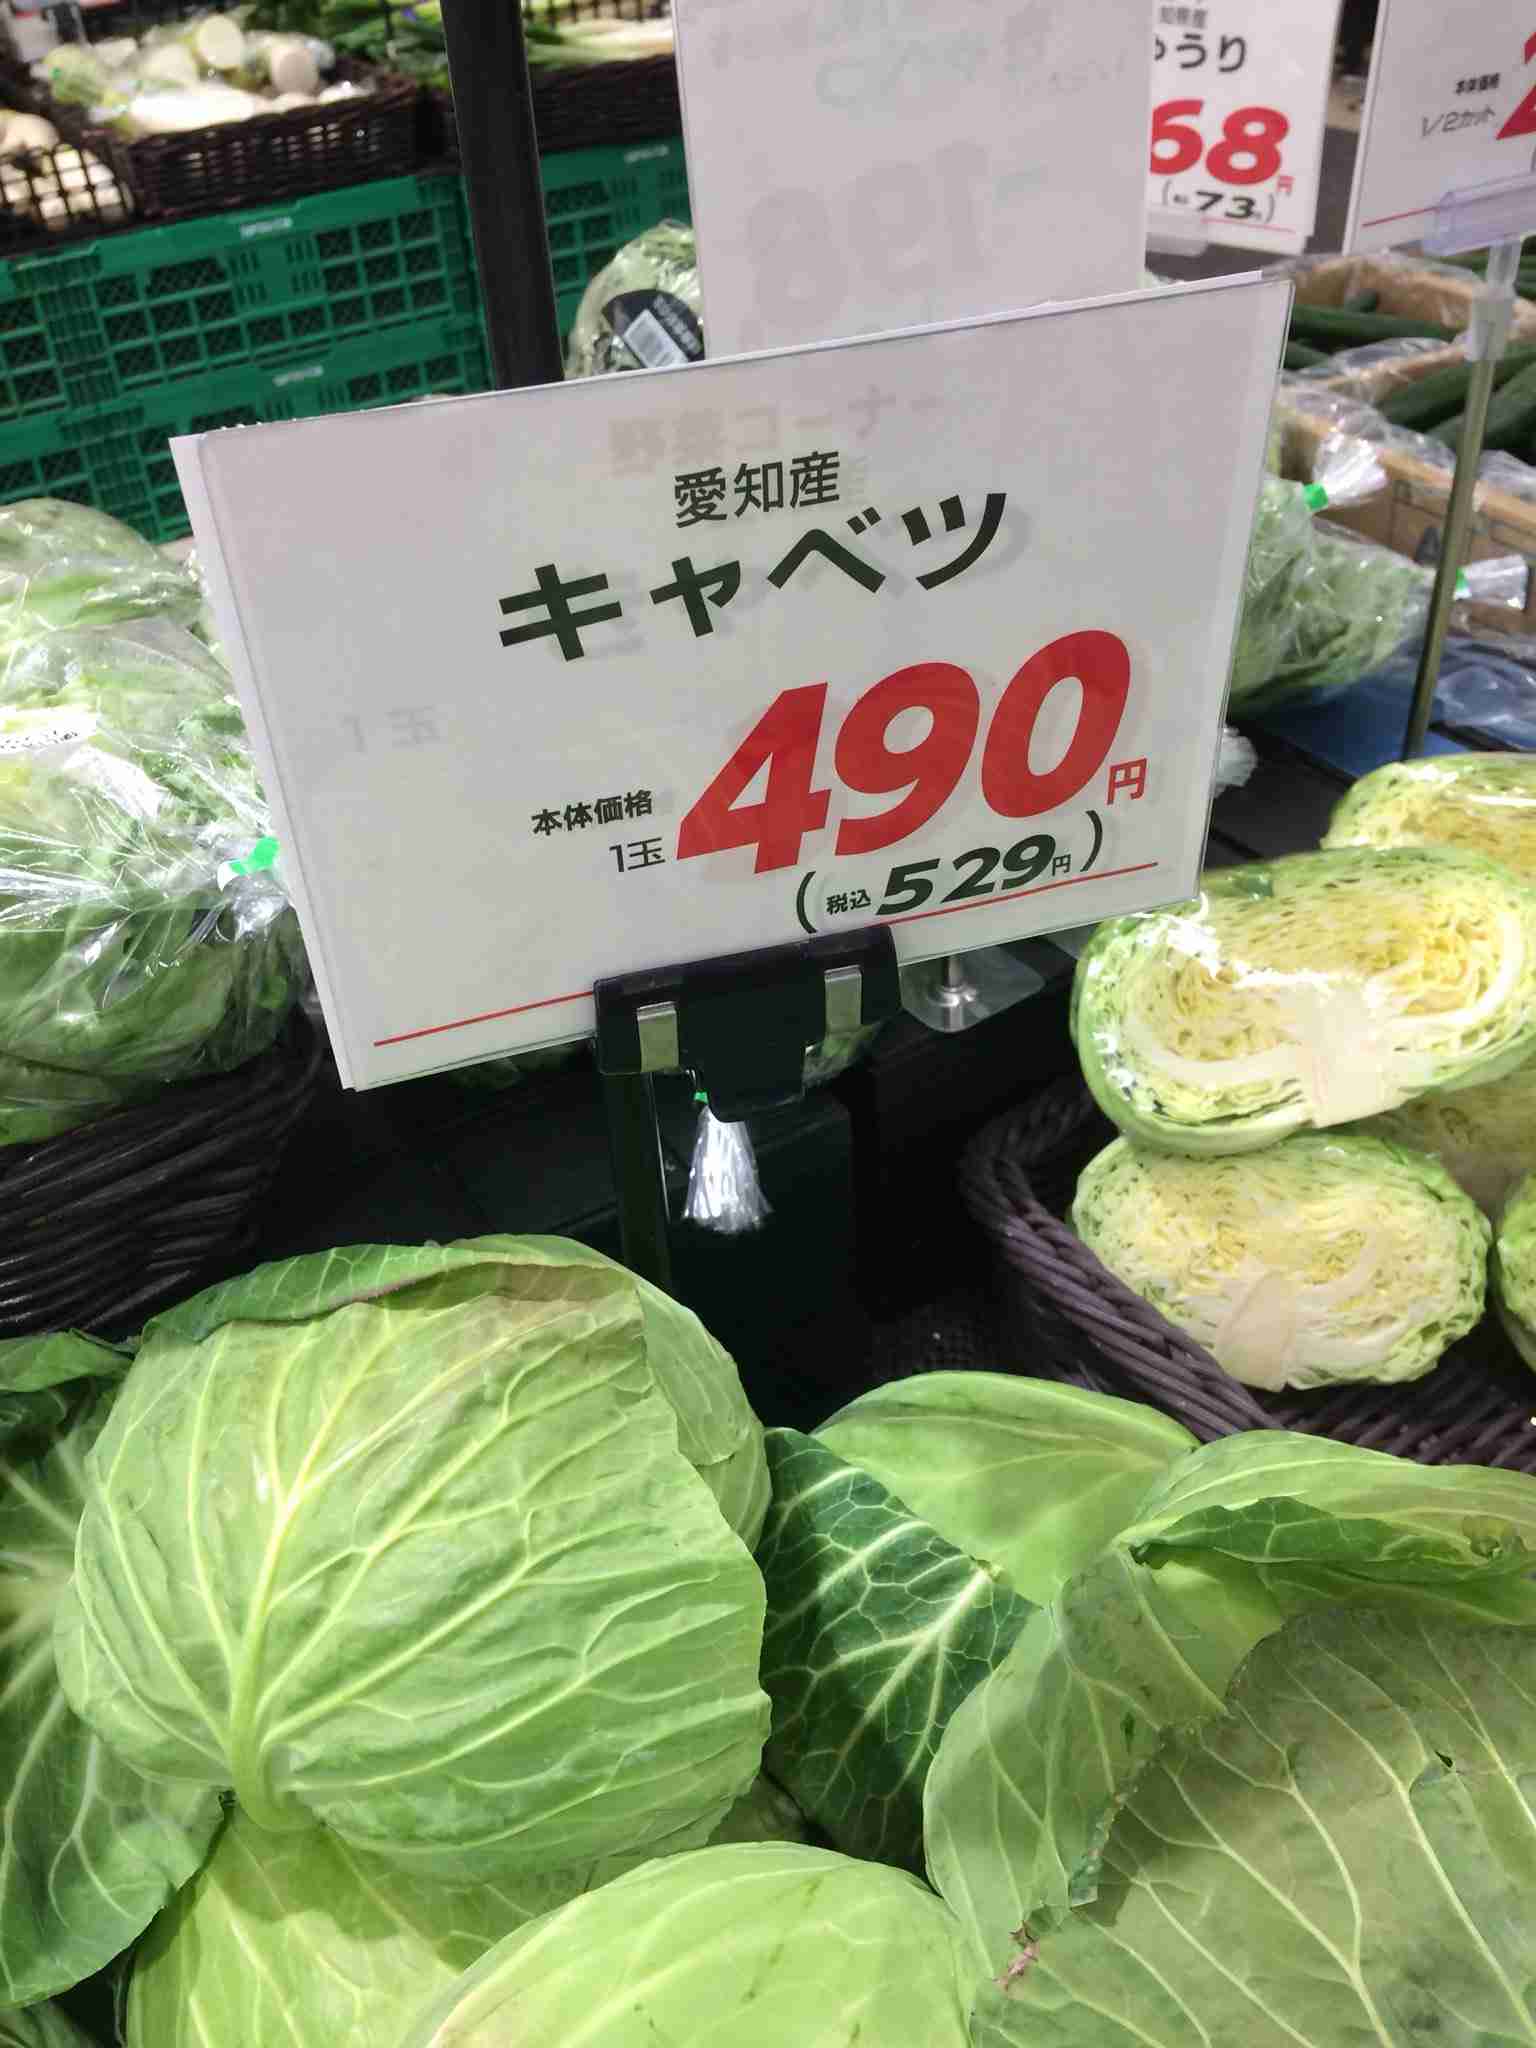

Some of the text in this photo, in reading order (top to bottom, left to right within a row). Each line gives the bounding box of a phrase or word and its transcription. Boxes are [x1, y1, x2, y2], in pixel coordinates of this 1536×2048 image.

[674, 450, 841, 529] 愛知産
[499, 492, 1008, 662] キャベツ
[531, 789, 653, 836] 本体価格
[609, 837, 666, 873] 1玉
